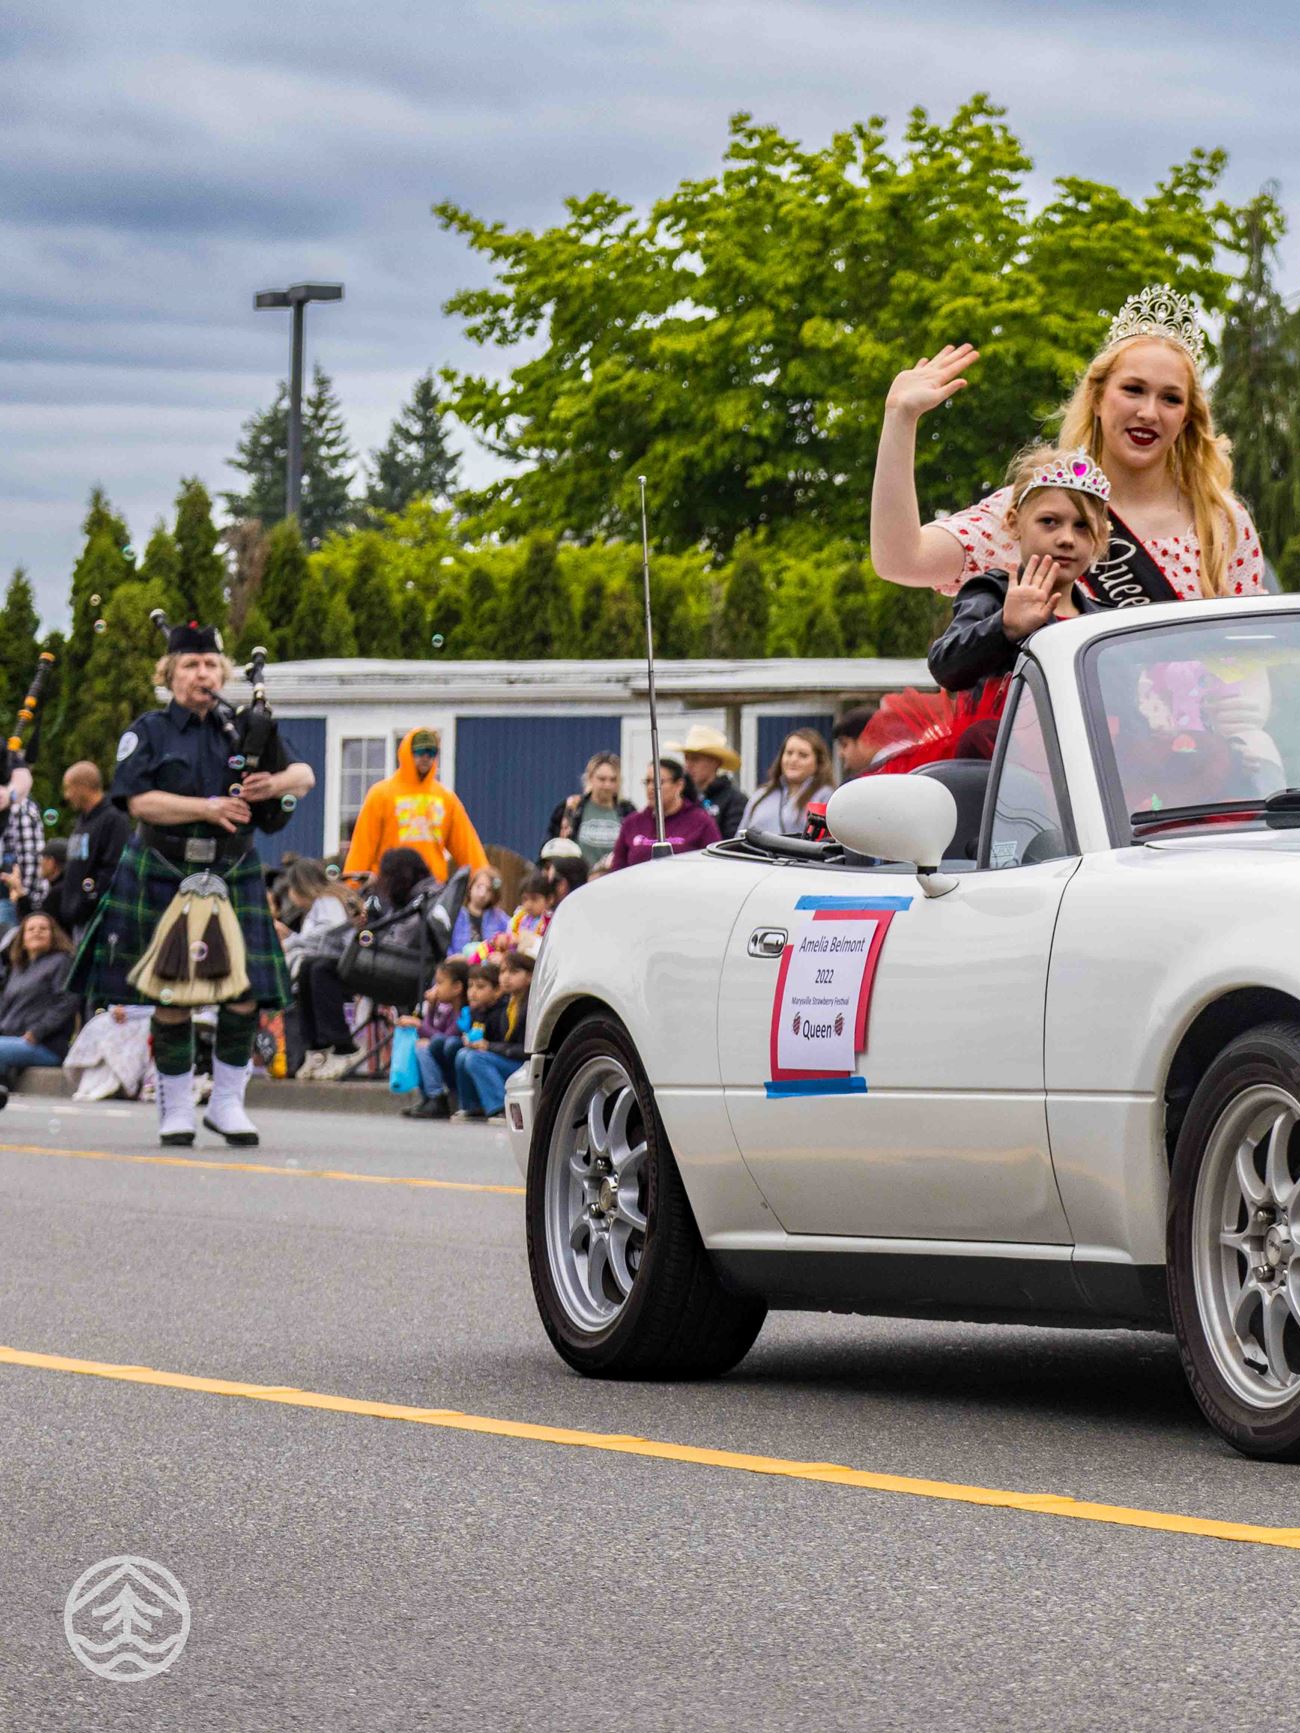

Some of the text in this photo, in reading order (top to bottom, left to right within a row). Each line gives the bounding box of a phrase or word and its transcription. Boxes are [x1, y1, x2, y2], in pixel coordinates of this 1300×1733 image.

[799, 936, 865, 952] Amelia Belmont
[815, 968, 834, 984] 2022
[791, 996, 850, 1007] Marysville Strawberry Festival
[802, 1019, 832, 1040] Queen
